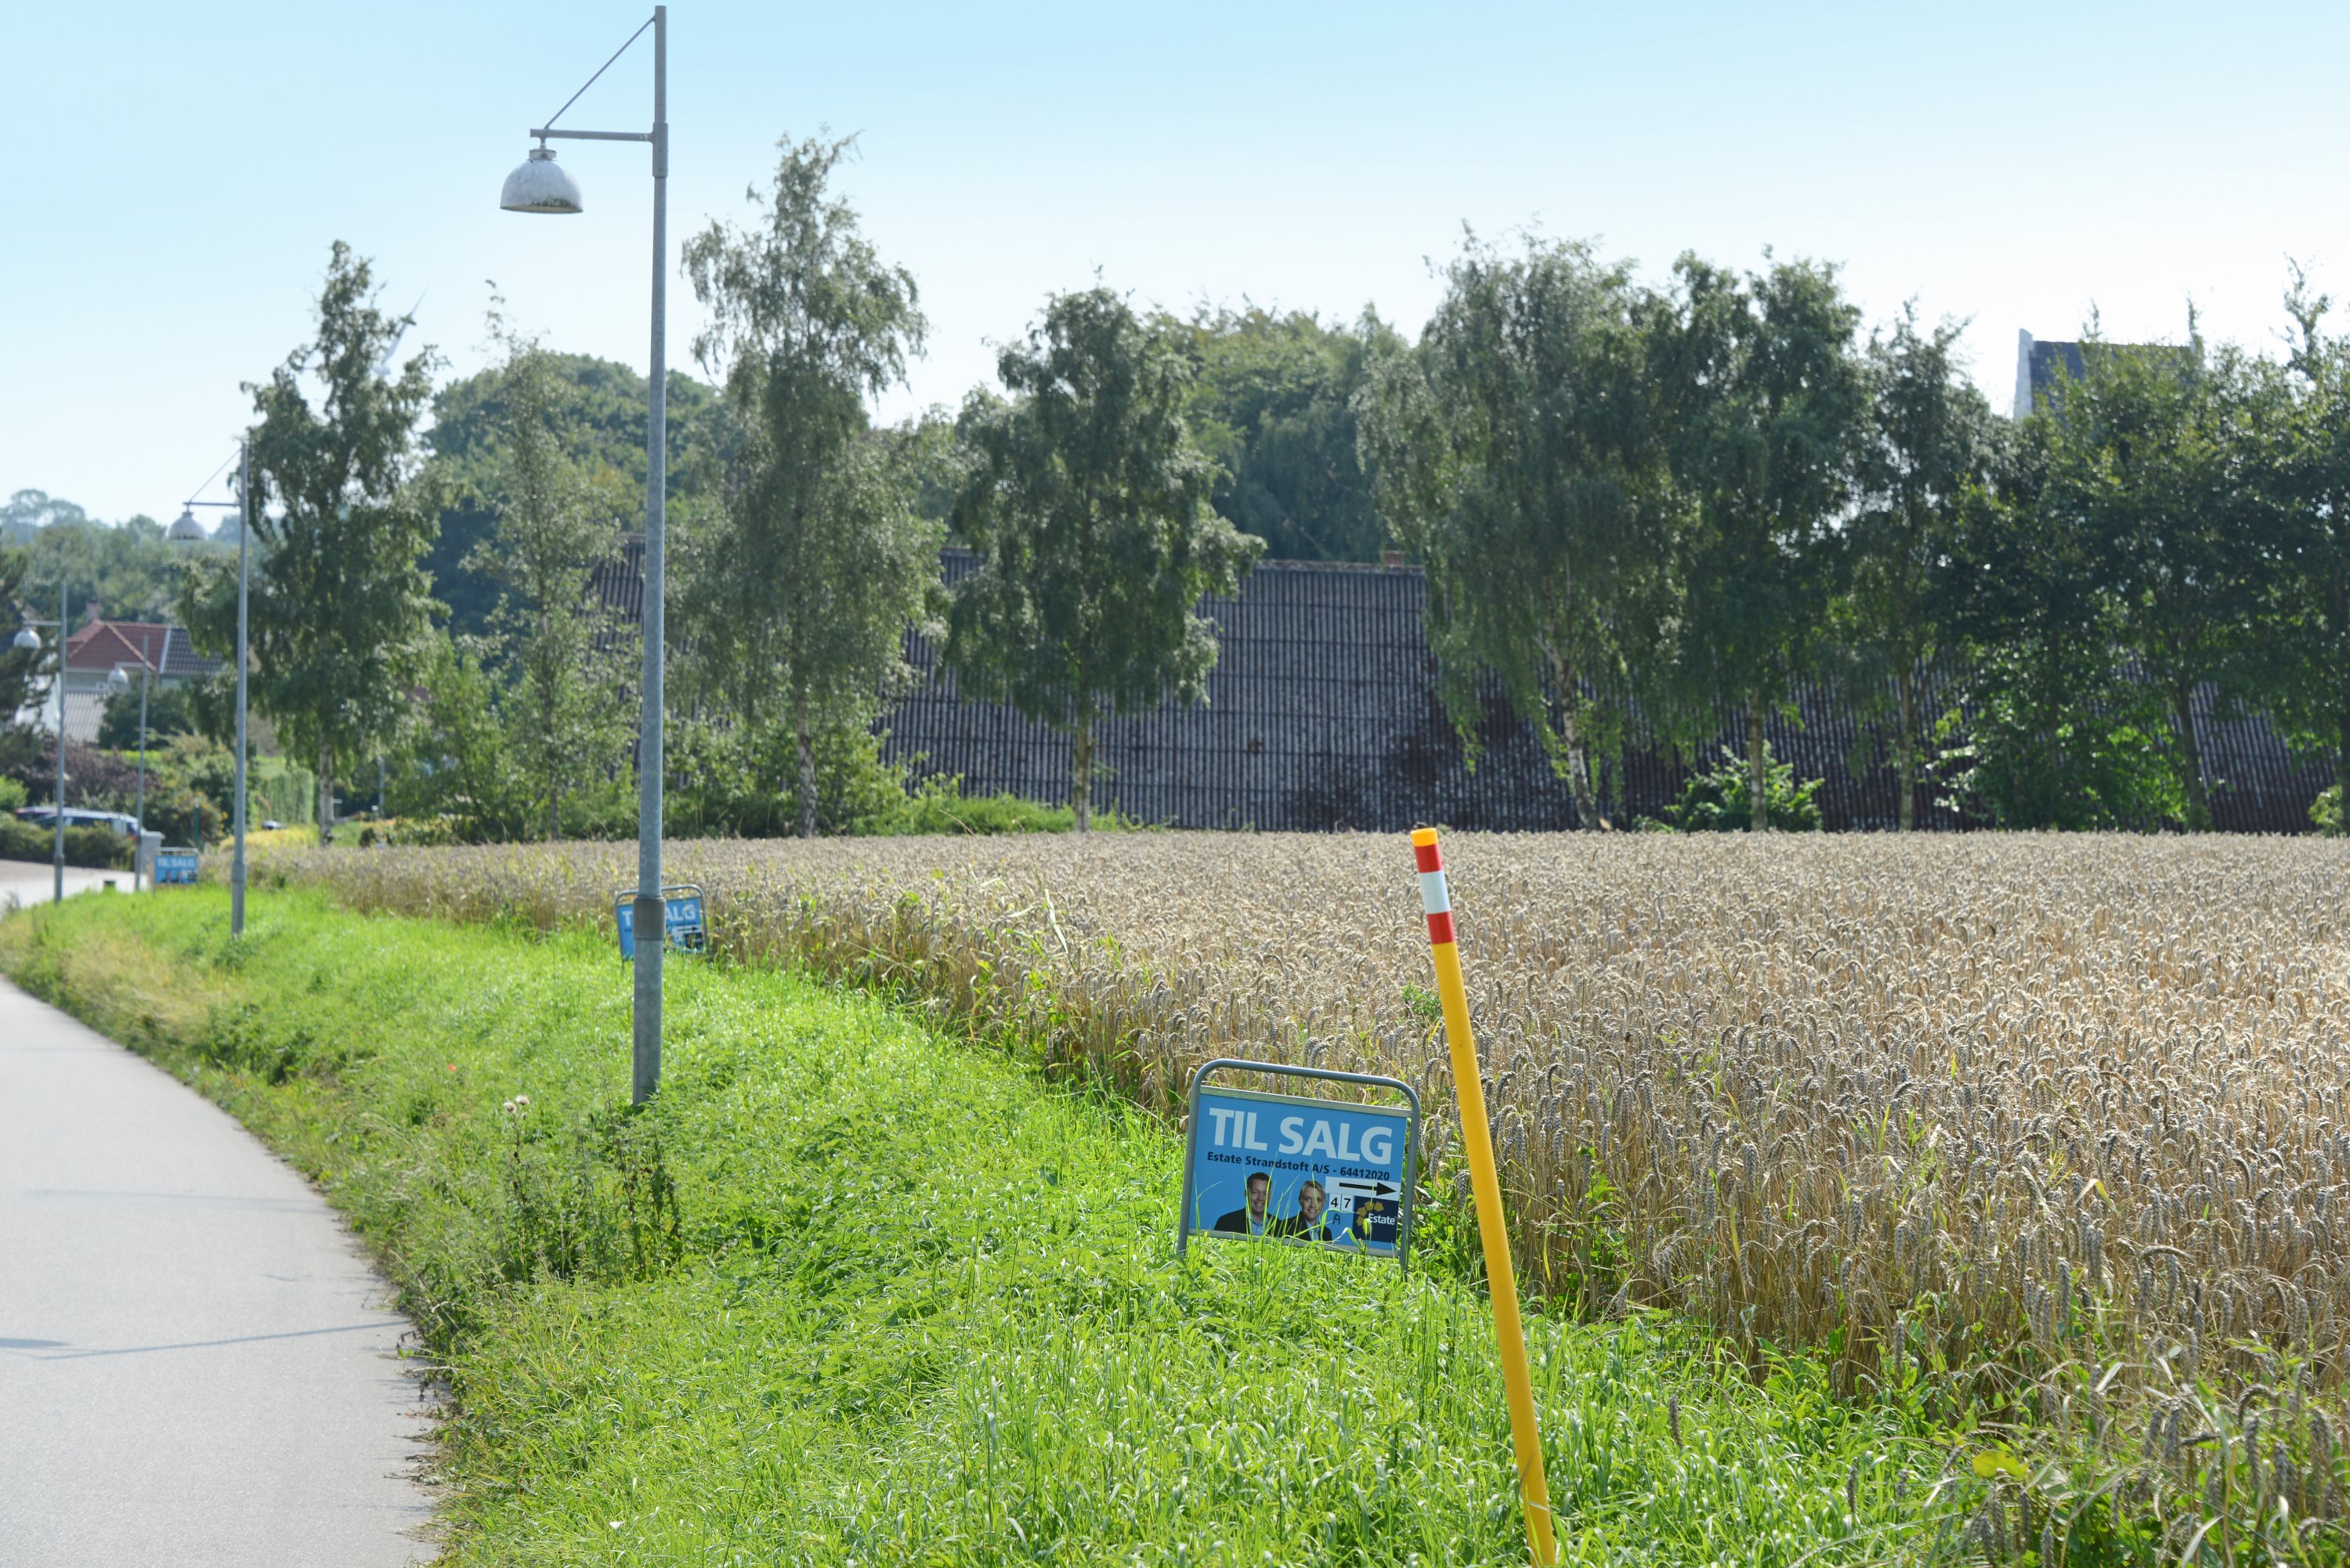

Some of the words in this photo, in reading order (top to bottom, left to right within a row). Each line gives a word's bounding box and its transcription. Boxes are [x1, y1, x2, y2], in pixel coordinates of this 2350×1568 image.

[172, 858, 195, 867] SALG
[1209, 1107, 1267, 1151] TIL
[1278, 1116, 1393, 1165] SALG
[1207, 1151, 1242, 1165] Estate
[1245, 1155, 1309, 1172] Strandstoft
[1312, 1164, 1330, 1174] A/S
[1340, 1166, 1390, 1181] 64412020
[1368, 1212, 1395, 1225] Estate
